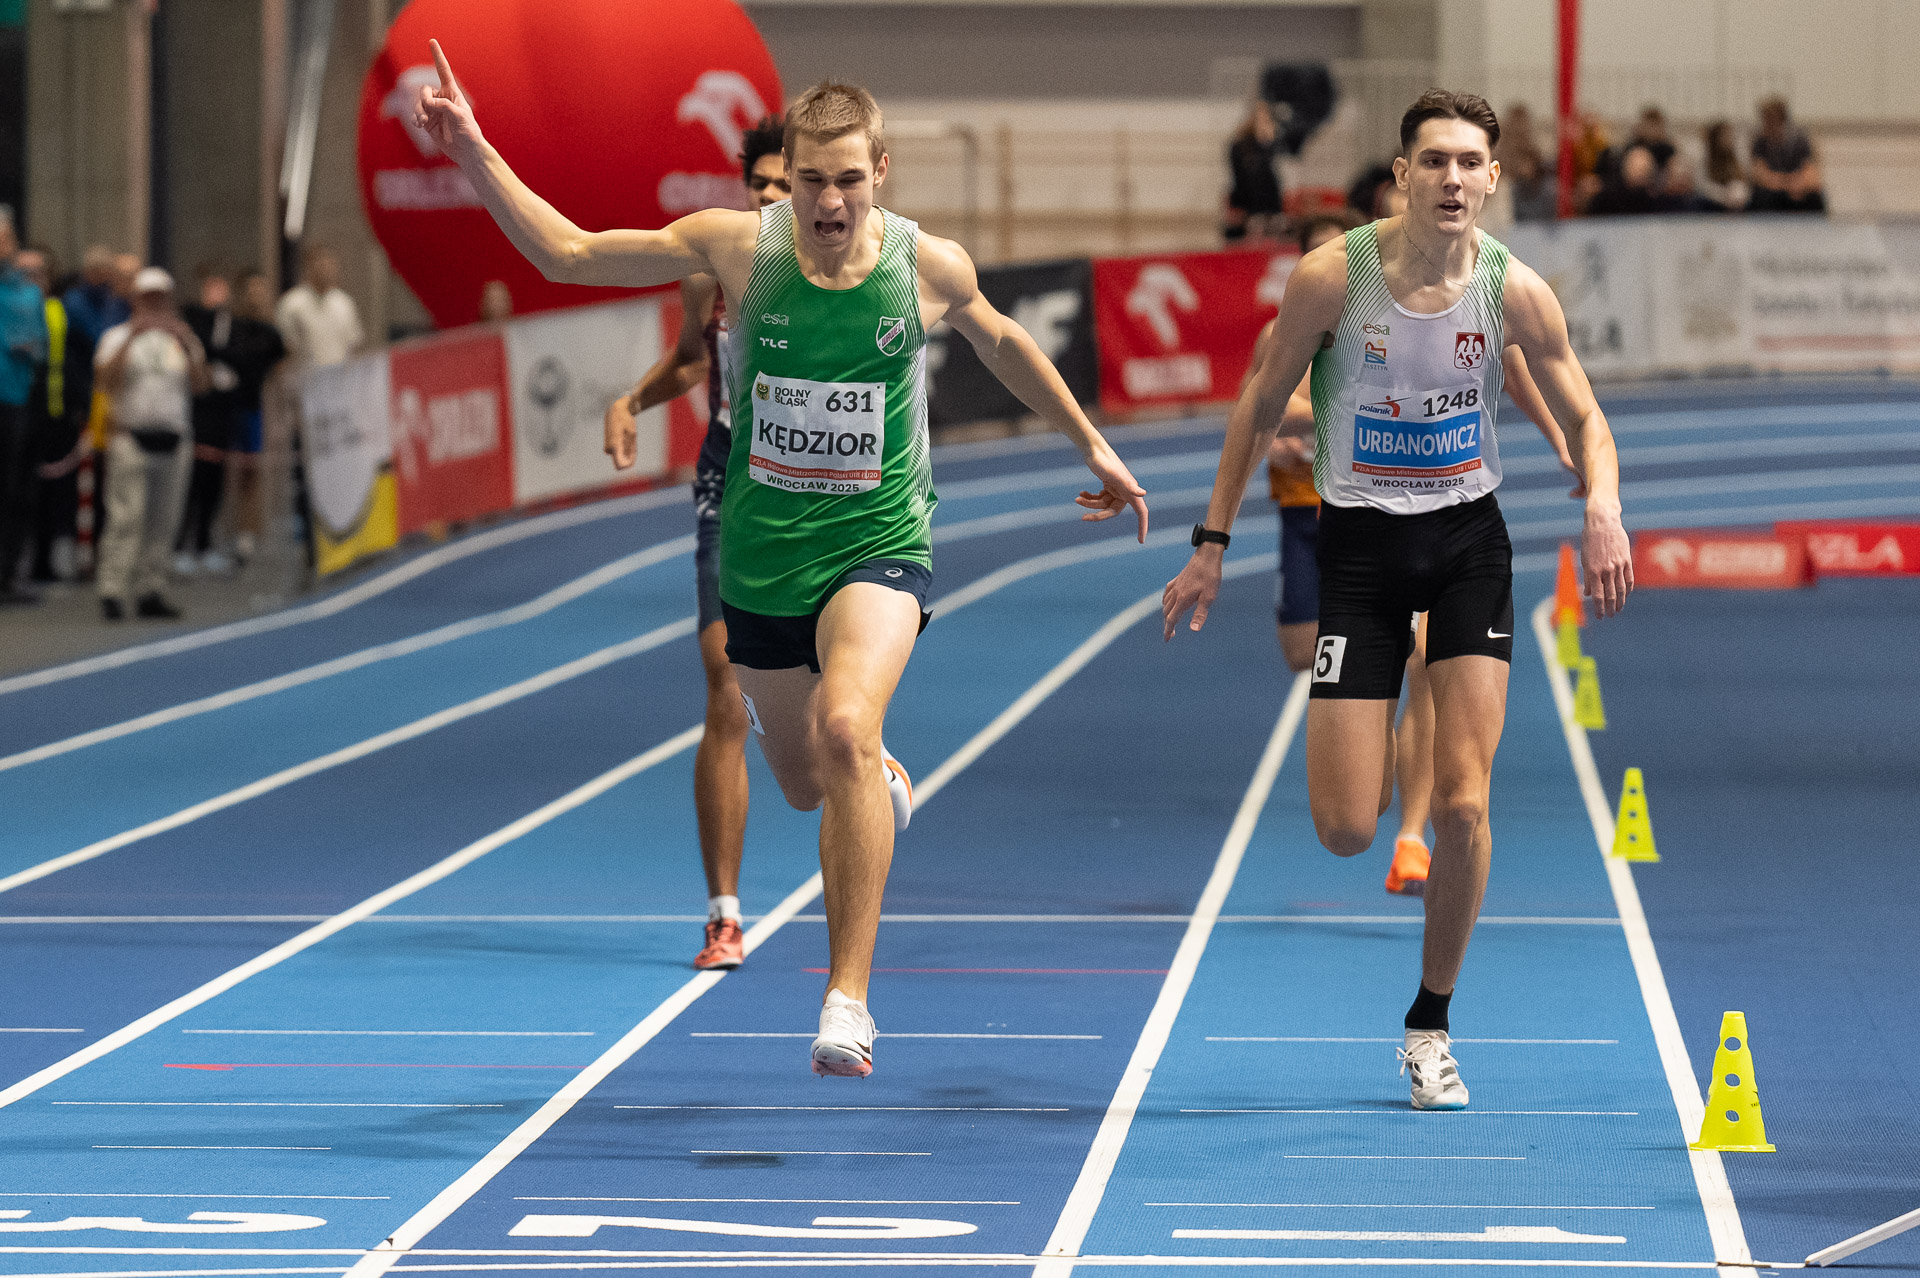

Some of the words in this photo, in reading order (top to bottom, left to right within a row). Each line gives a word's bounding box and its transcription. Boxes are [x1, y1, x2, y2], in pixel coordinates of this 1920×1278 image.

[760, 337, 788, 349] TLC
[775, 386, 811, 398] DOLNY
[825, 391, 874, 412] 631
[1359, 404, 1391, 415] polanik
[1423, 388, 1478, 417] 1248
[758, 418, 877, 456] KĘDZIOR
[1358, 423, 1477, 456] URBANOWICZ
[788, 468, 828, 477] Mistrzostwa
[830, 471, 848, 479] Polski
[1355, 465, 1370, 473] PZLA
[1371, 468, 1396, 476] Halowe
[1436, 469, 1454, 477] Polski
[1467, 461, 1479, 470] U20
[766, 474, 828, 490] WROCŁAW
[830, 484, 860, 492] 2025
[1371, 478, 1436, 488] WROCŁAW
[1438, 476, 1465, 488] 2025
[1316, 639, 1335, 677] 5
[0, 1210, 327, 1233] 3
[508, 1214, 978, 1239] 2
[1171, 1226, 1627, 1243] 1
